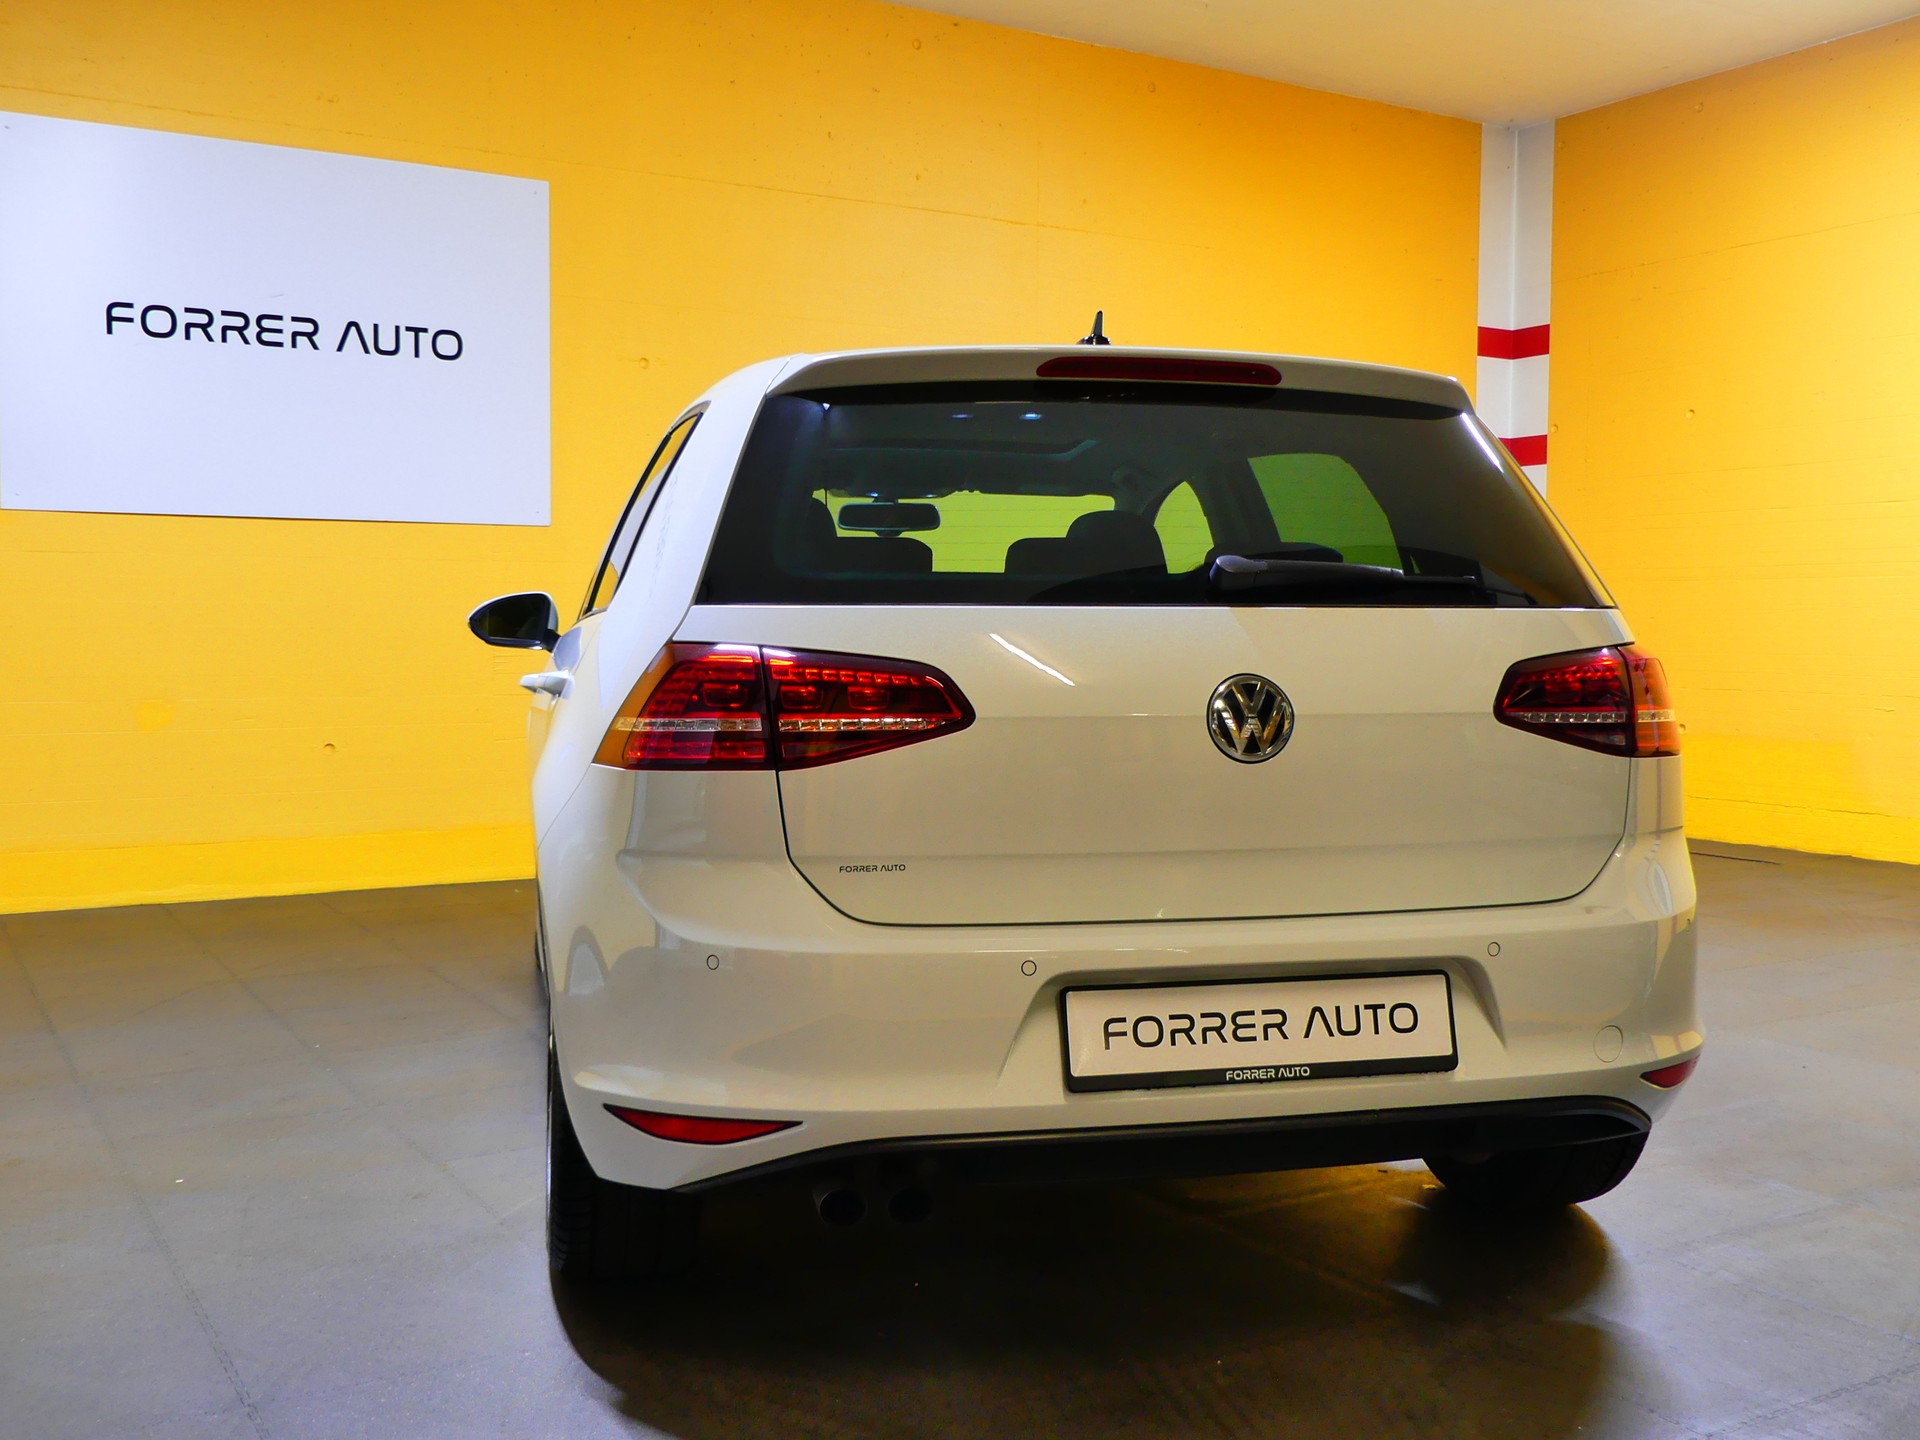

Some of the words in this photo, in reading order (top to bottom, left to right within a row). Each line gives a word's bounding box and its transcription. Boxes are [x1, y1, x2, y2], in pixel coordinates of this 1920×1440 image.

[106, 301, 320, 351] FORRER
[336, 320, 464, 361] AUTO
[1210, 676, 1291, 760] VW
[839, 864, 878, 873] FORRER
[880, 863, 906, 872] AUTO
[1103, 1008, 1289, 1051] FORRER
[1303, 1002, 1419, 1039] AUTO
[1225, 1068, 1276, 1081] FORRER
[1278, 1066, 1310, 1078] AUTO
